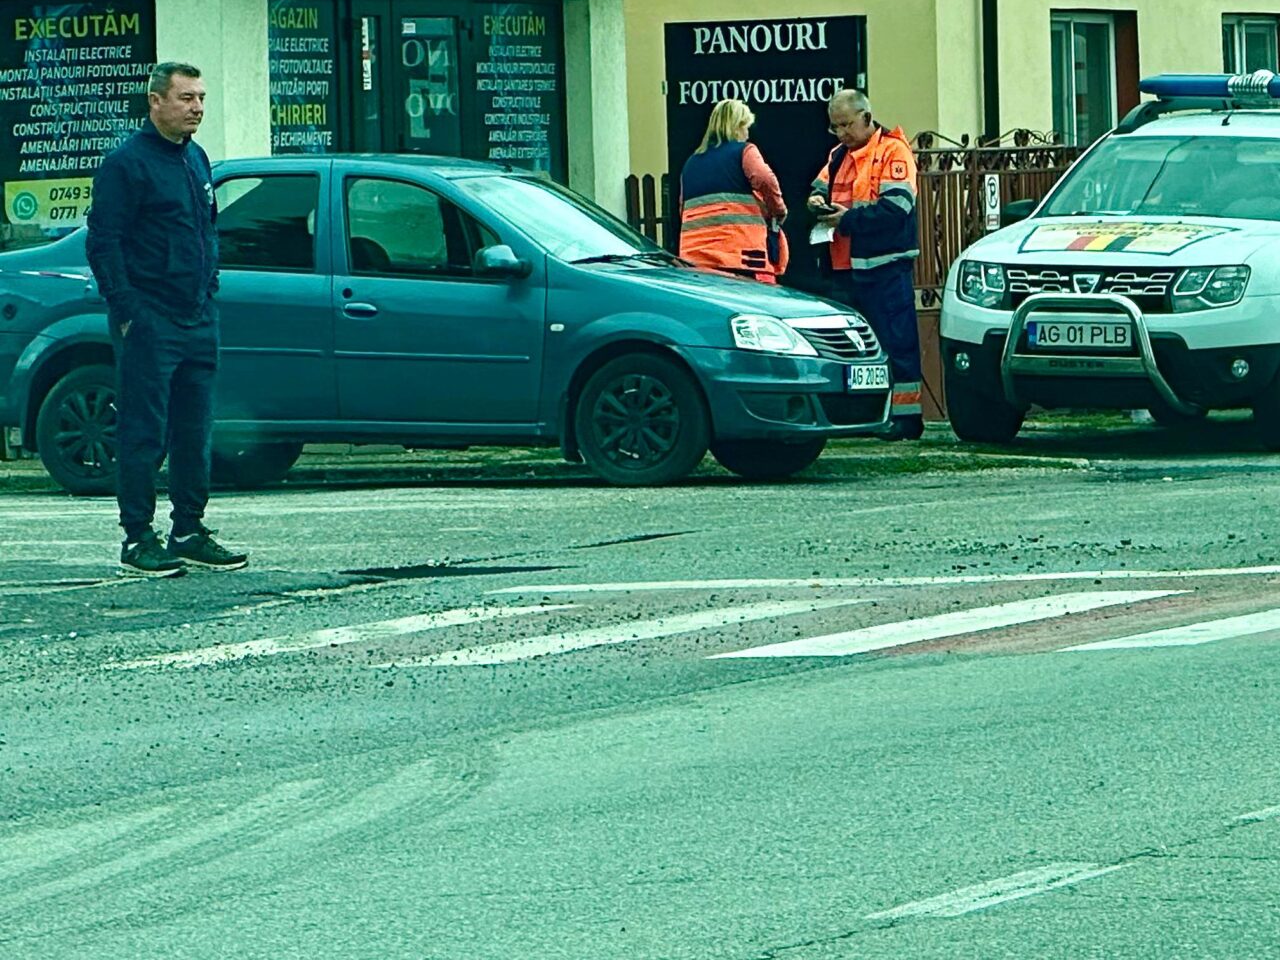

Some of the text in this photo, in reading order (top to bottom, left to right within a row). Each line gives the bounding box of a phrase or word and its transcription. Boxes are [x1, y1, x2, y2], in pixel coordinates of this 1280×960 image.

[15, 8, 140, 40] EXECUTĂM
[271, 7, 318, 29] AGAZIN
[291, 37, 329, 52] ELECTRICE
[693, 21, 828, 55] PANOURI
[24, 45, 132, 62] INSTALAȚII ELECTRICE
[41, 66, 86, 80] PANOURI
[280, 59, 332, 74] FOTOVOLTAICE
[54, 83, 104, 98] SANITARE
[105, 83, 115, 97] ȘI
[117, 81, 149, 95] TERMI
[270, 77, 306, 96] MATIZĂRI
[30, 100, 130, 118] CONSTRUCȚII CIVILE
[270, 104, 327, 126] CHIRIERI
[13, 120, 80, 137] CONSTRUCȚII
[20, 137, 79, 154] AMENAJĂRI
[280, 131, 332, 146] ECHIPAMENTE
[20, 154, 78, 172] AMENAJĂRI
[49, 186, 92, 201] 0749 3
[50, 205, 77, 220] 0771
[1038, 325, 1127, 343] AG 01 PLB
